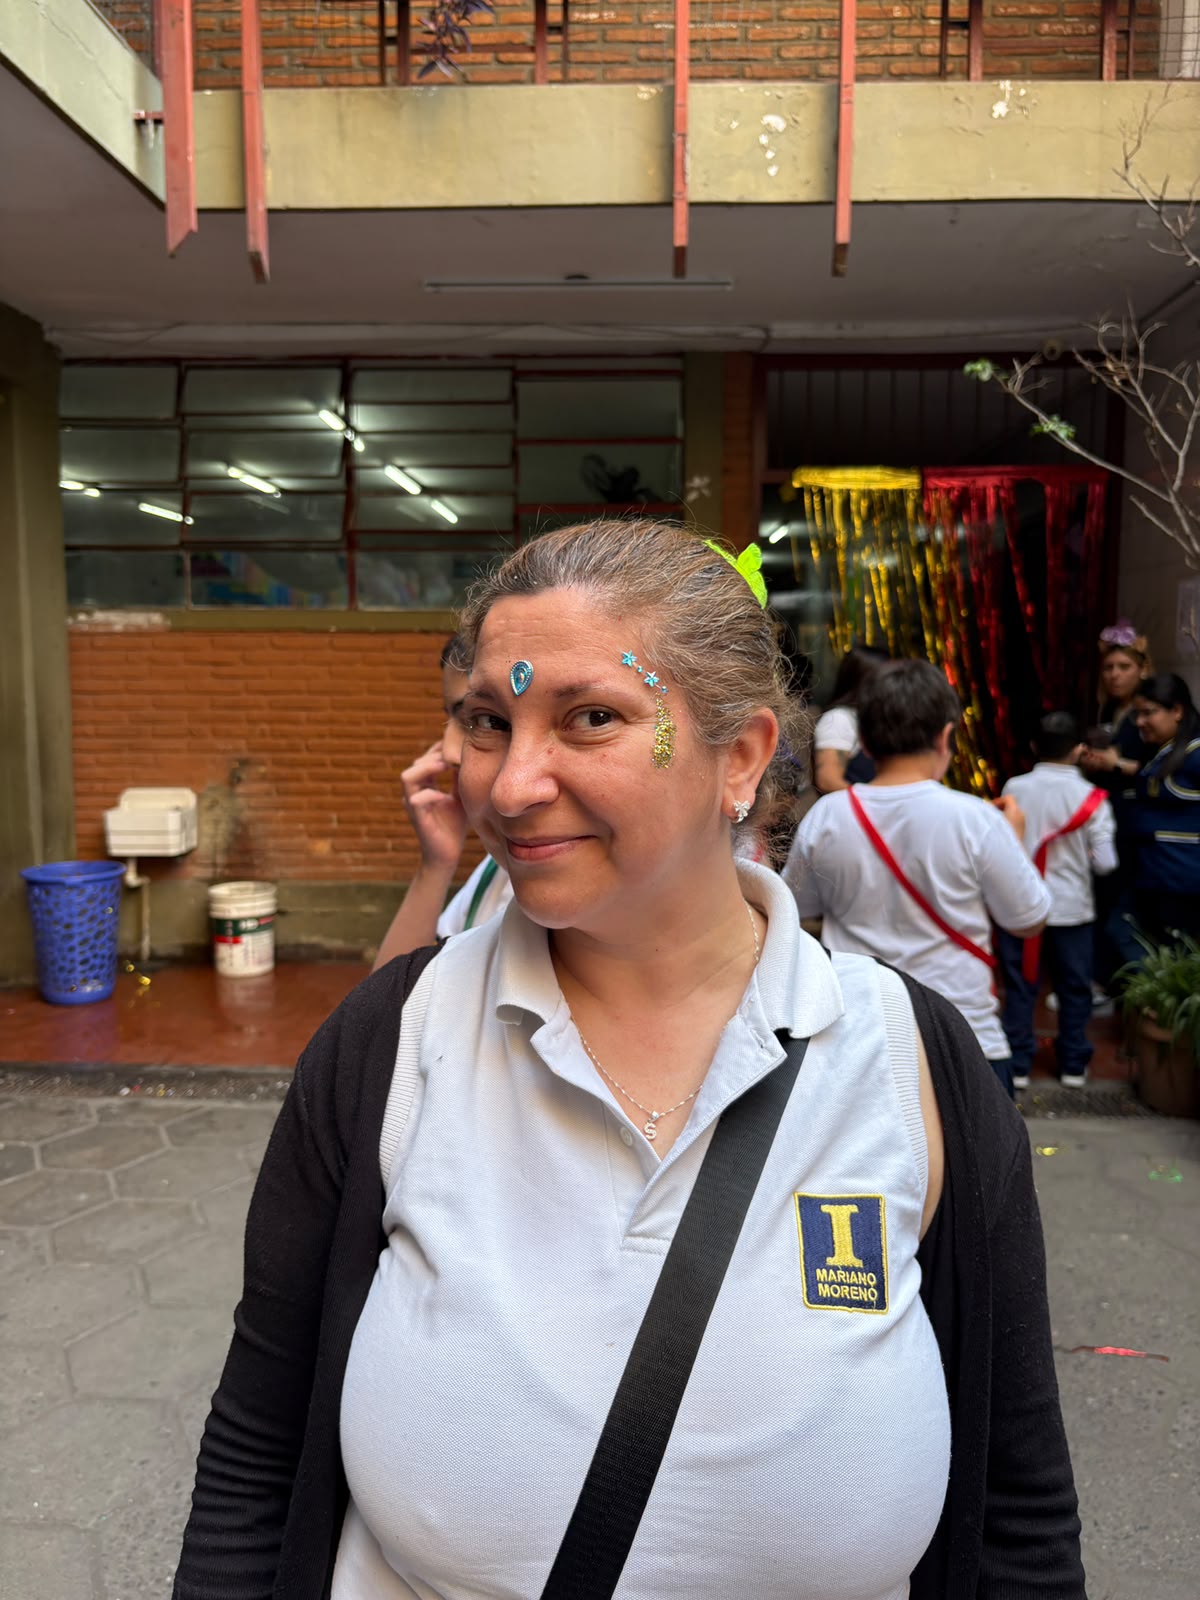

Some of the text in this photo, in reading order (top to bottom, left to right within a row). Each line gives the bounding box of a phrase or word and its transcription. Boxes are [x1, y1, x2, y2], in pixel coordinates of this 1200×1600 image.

[644, 1122, 657, 1140] S
[820, 1204, 864, 1268] I
[815, 1268, 877, 1286] MARIANO
[817, 1283, 878, 1302] MORENO
